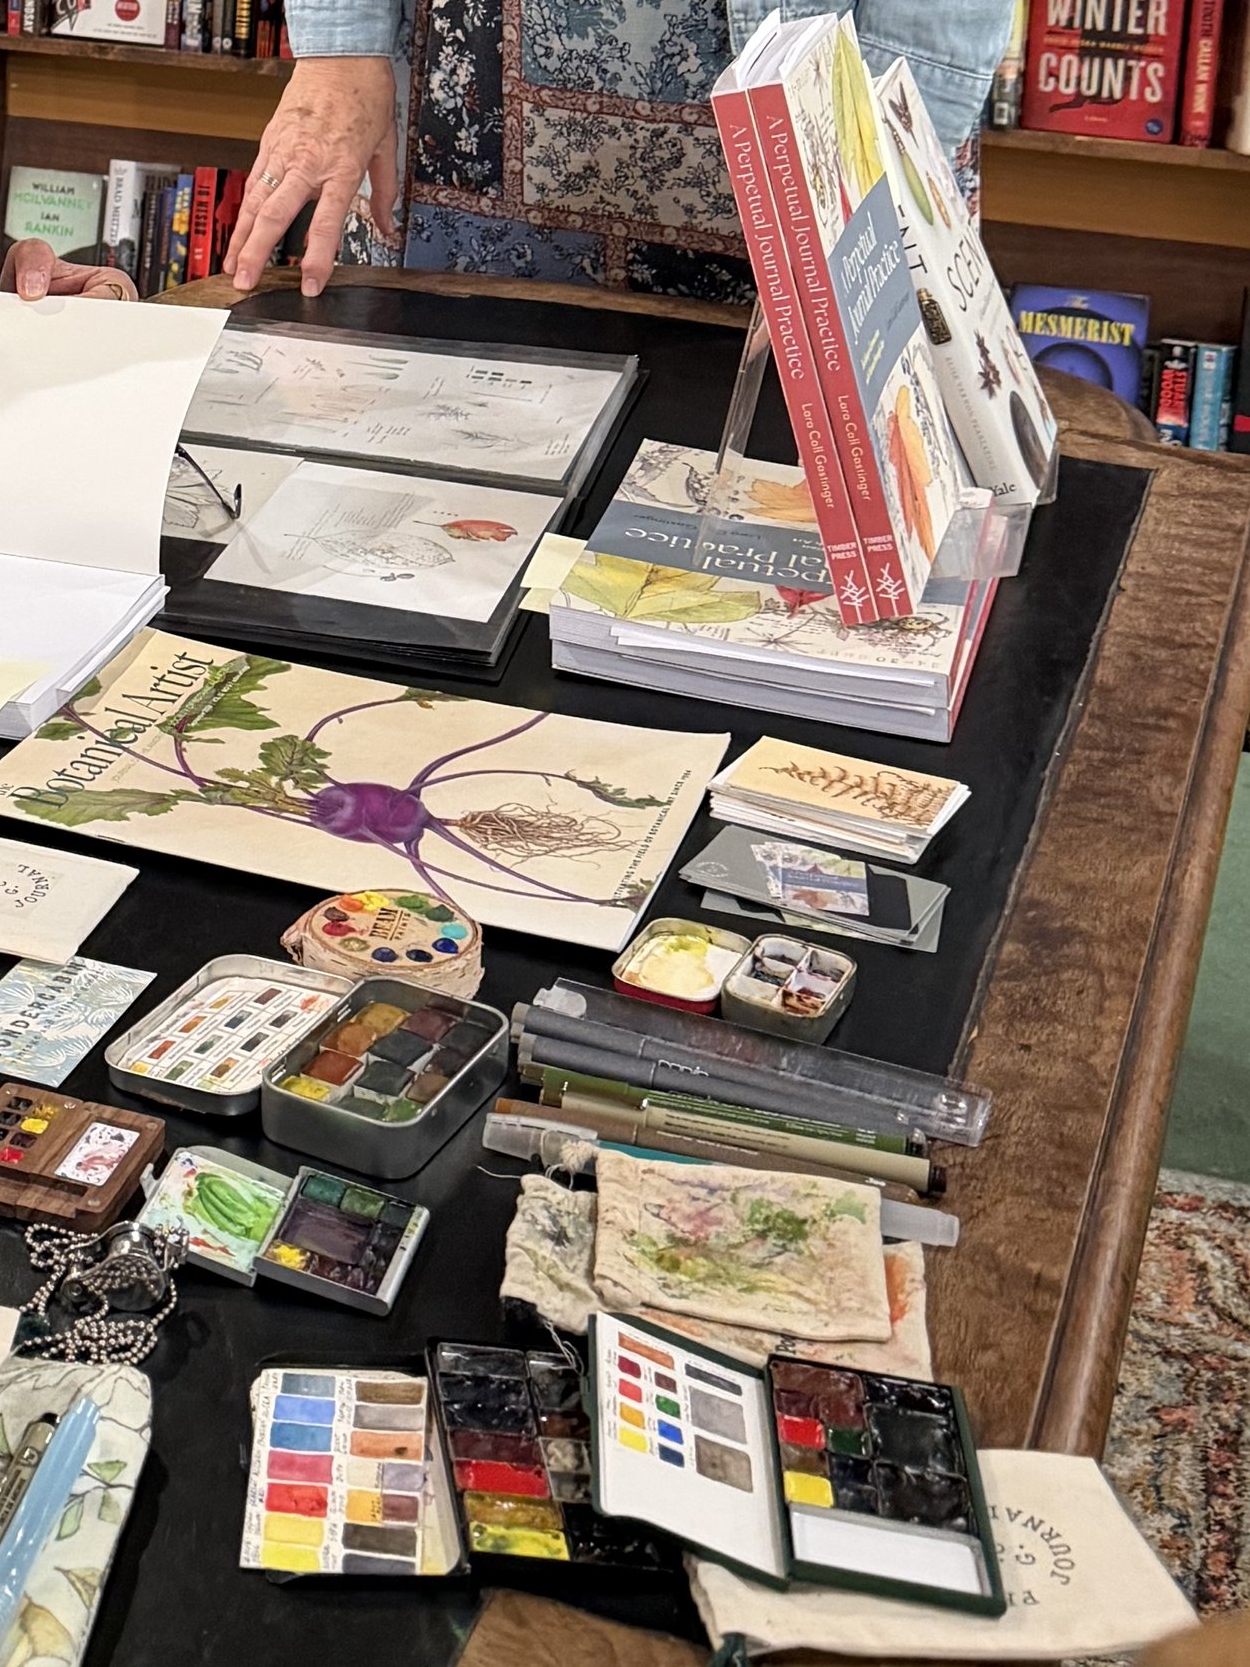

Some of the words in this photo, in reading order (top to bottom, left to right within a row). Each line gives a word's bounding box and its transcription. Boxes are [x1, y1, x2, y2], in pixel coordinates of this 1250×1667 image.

[1038, 52, 1165, 103] COUNTS
[730, 124, 747, 139] A
[766, 115, 785, 130] A
[31, 182, 75, 195] WILLIAM
[735, 141, 773, 231] Perpetual
[771, 132, 810, 222] Perpetual
[13, 192, 94, 211] MCILVANNEY
[41, 211, 60, 222] IAN
[24, 223, 75, 238] RANKIN
[790, 225, 827, 294] Journal
[842, 210, 878, 284] Perpetual
[754, 233, 785, 301] Journal
[868, 239, 902, 296] Practice
[775, 303, 805, 381] Practice
[811, 295, 841, 372] Practice
[1018, 310, 1136, 346] MESMERIST
[801, 402, 814, 430] Lara
[837, 394, 850, 422] Lara
[808, 430, 825, 454] Coll
[844, 422, 861, 446] Coll
[814, 454, 835, 509] Gastinger
[851, 446, 872, 501] Gastinger
[991, 482, 1017, 498] Yale
[826, 541, 857, 553] TIMBER
[862, 534, 893, 547] TIMBER
[867, 543, 894, 553] PRESS
[831, 551, 858, 561] PRESS
[7, 705, 157, 810] Botanical
[121, 651, 215, 716] Artist
[14, 864, 50, 908] JOURNAL
[369, 907, 400, 940] BEAM
